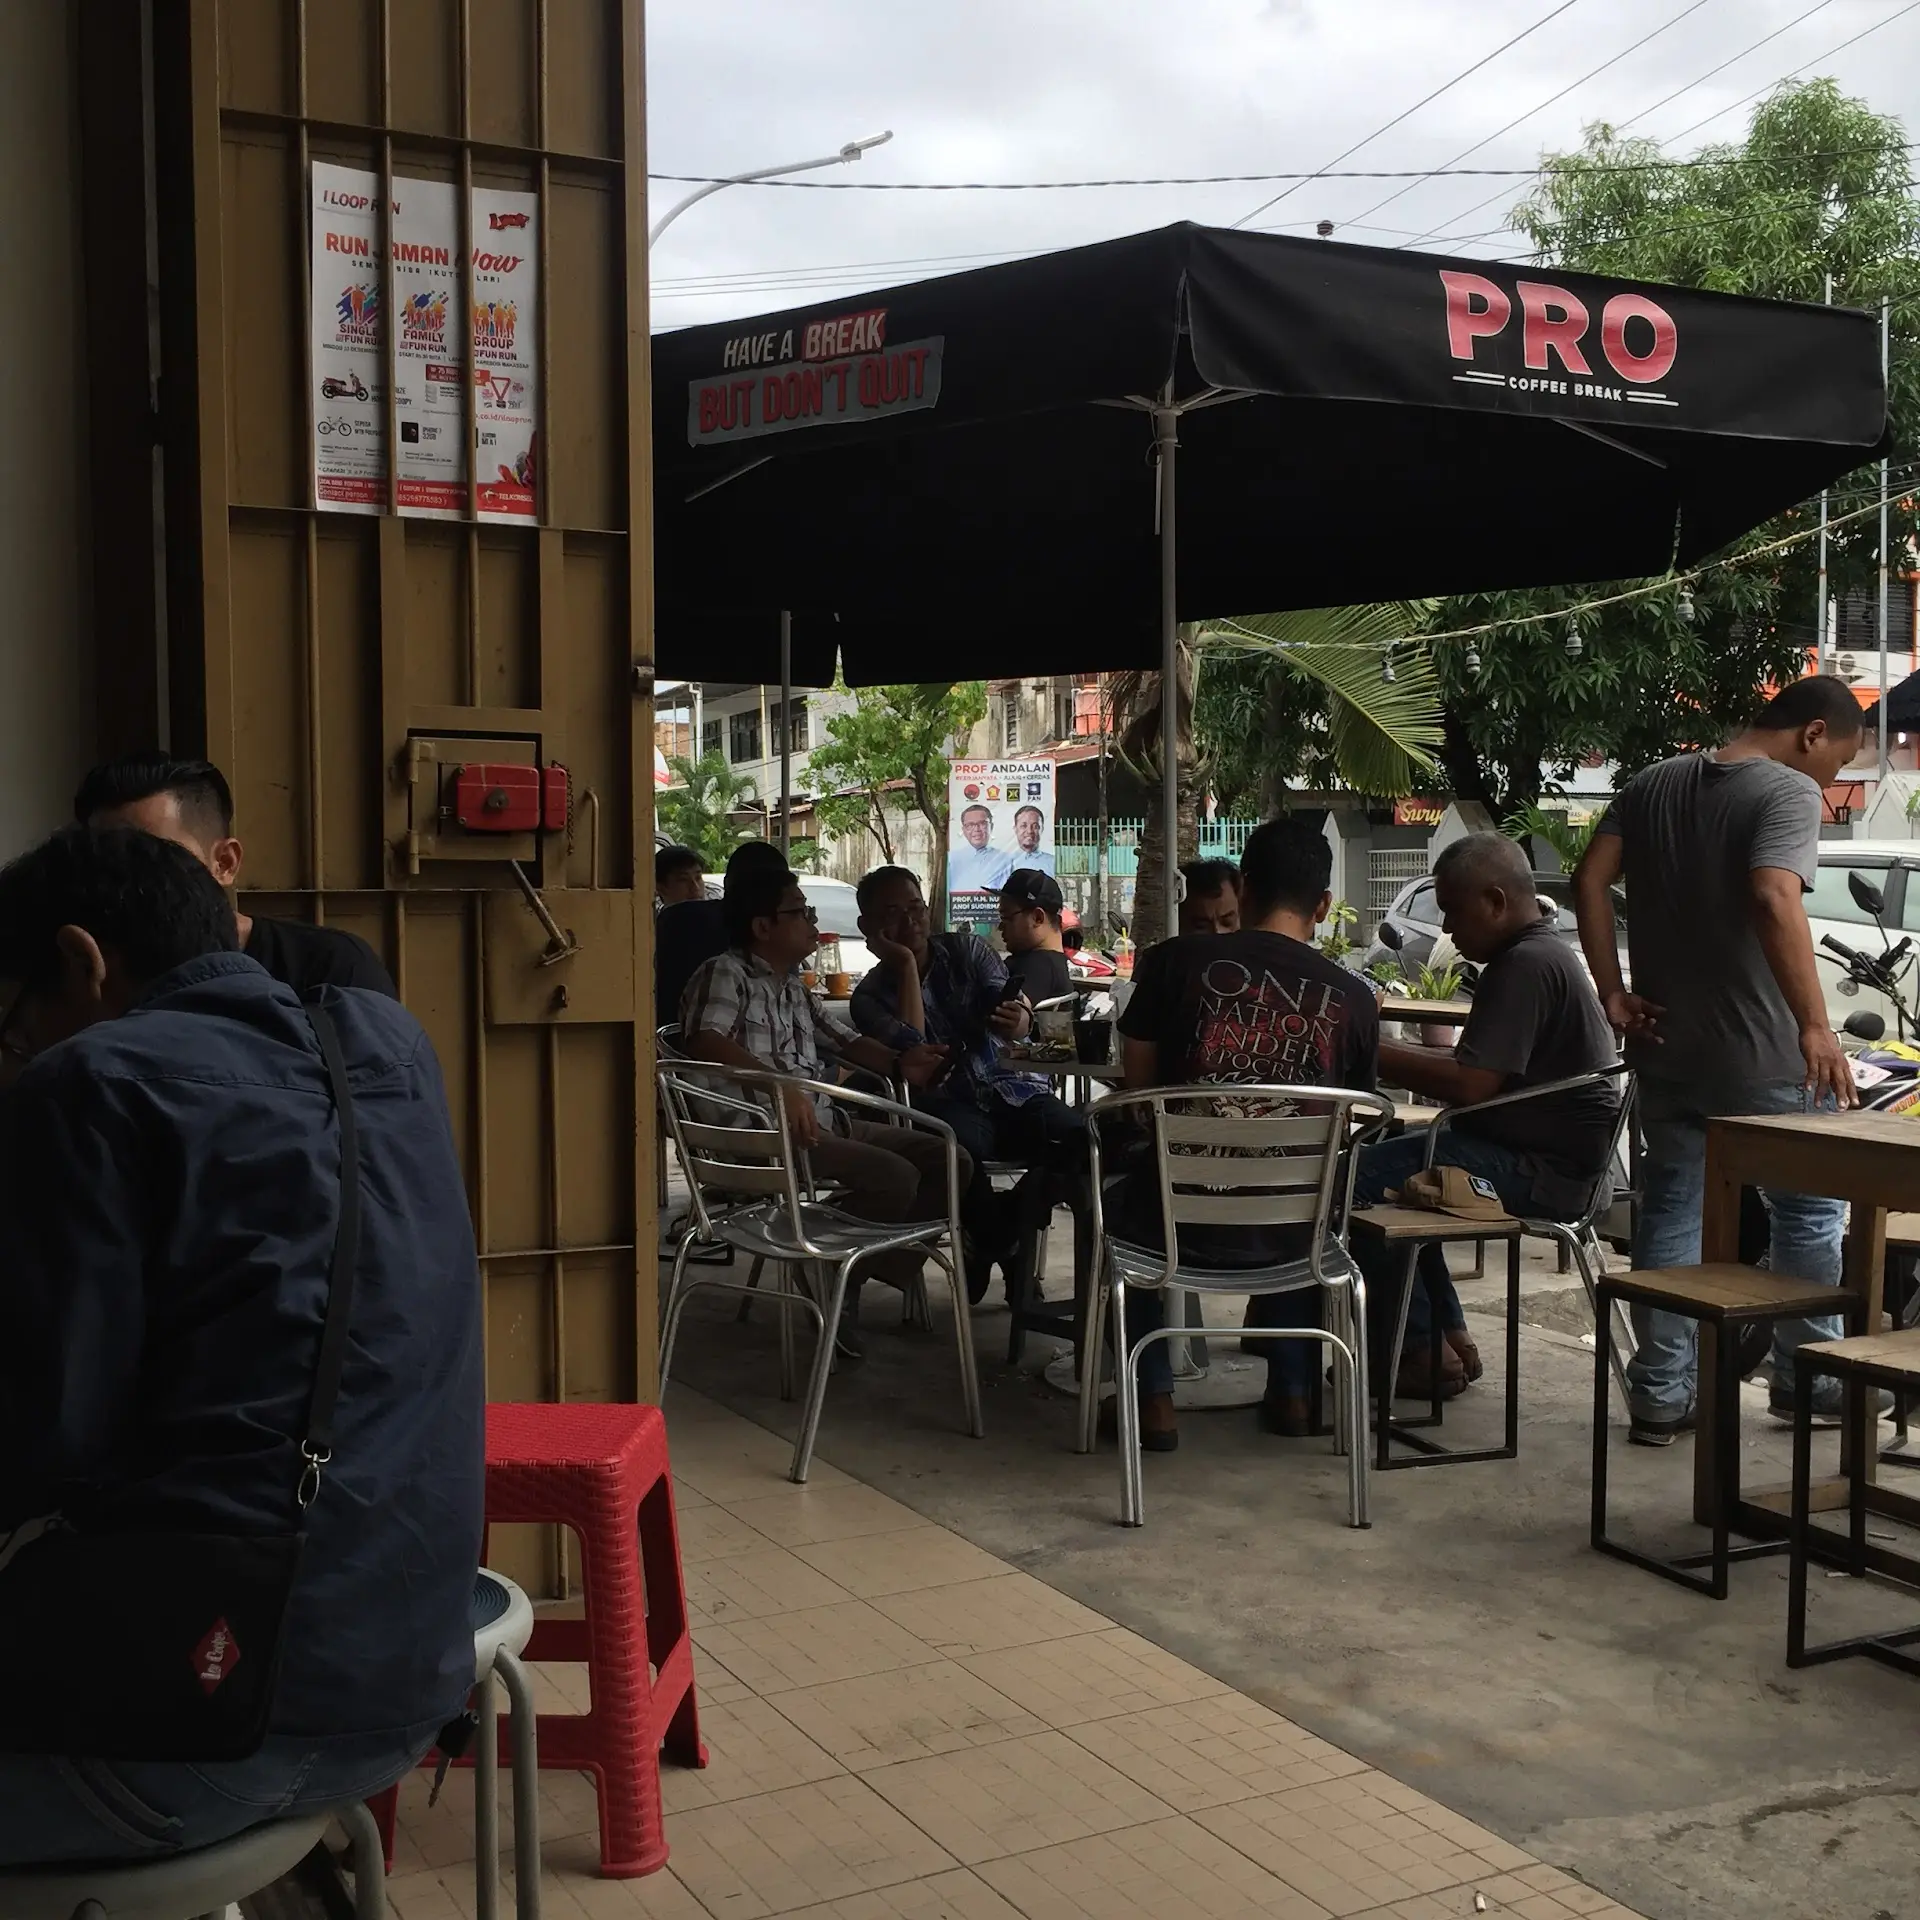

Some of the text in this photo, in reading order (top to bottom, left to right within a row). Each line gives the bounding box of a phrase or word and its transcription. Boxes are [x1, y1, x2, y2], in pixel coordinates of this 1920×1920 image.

[331, 192, 369, 210] LOOP
[371, 199, 401, 215] RN
[326, 233, 369, 257] RUN
[476, 275, 500, 283] LARI
[340, 324, 378, 337] SINGLE
[404, 329, 445, 342] FAMILY
[1439, 270, 1677, 383] PRO
[344, 334, 363, 345] FUN
[409, 342, 427, 351] FUN
[428, 343, 447, 353] RUN
[474, 336, 514, 349] GROUP
[724, 312, 887, 368] HAVE A BREAK
[479, 350, 517, 361] FUN RUN
[700, 348, 928, 433] BUT DON'T QUIT
[1508, 377, 1622, 402] COFFEE BREAK
[319, 488, 344, 497] Contact
[345, 491, 368, 500] person
[955, 763, 1050, 773] PROF ANDALAN
[1202, 959, 1345, 1025] ONE
[1198, 996, 1334, 1046] NATION
[1196, 1020, 1325, 1073] UNDER
[1186, 1043, 1325, 1086] HYPOCRISY
